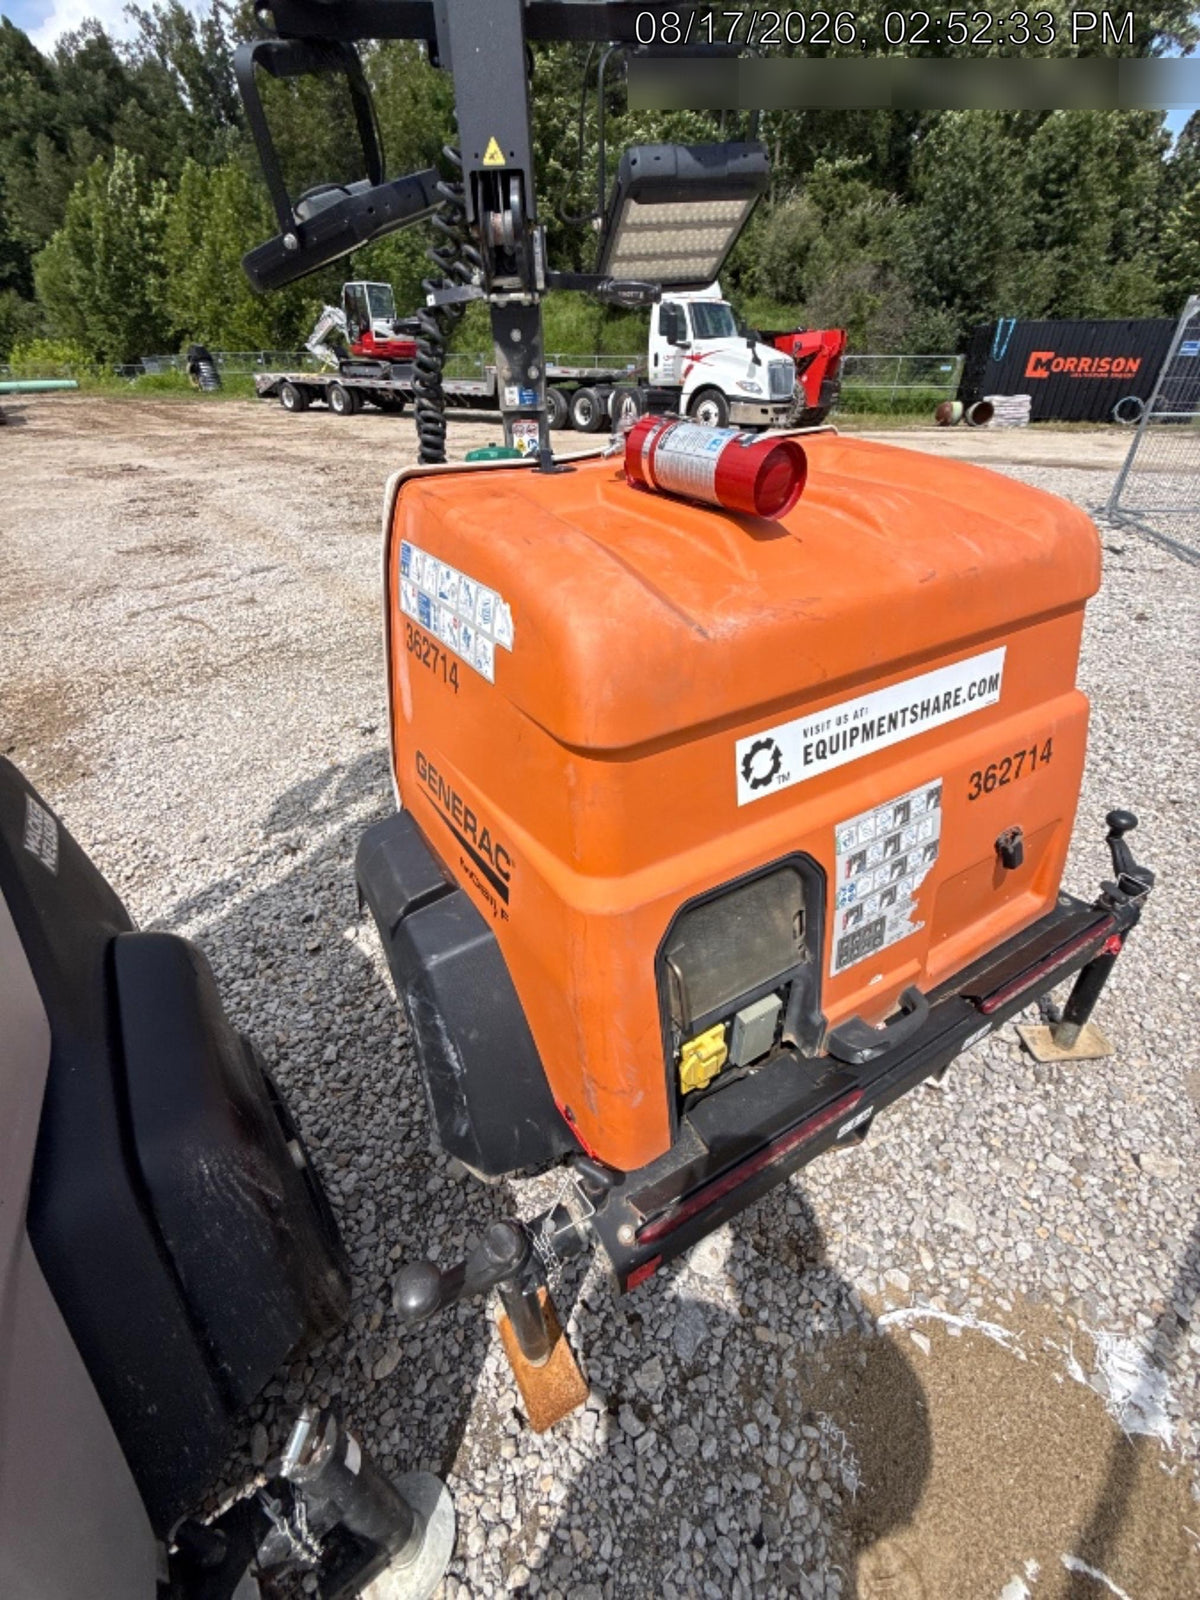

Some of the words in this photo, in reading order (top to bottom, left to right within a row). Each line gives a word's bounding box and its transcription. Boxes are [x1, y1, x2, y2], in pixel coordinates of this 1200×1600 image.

[1024, 351, 1142, 378] MORRISON
[405, 623, 459, 694] 362714
[802, 672, 1000, 766] EQUIPMENTSHARE.COM
[803, 719, 832, 739] VISIT
[836, 713, 850, 727] US
[853, 706, 869, 720] AT:
[967, 737, 1053, 801] 362714
[415, 749, 511, 882] GENERAC
